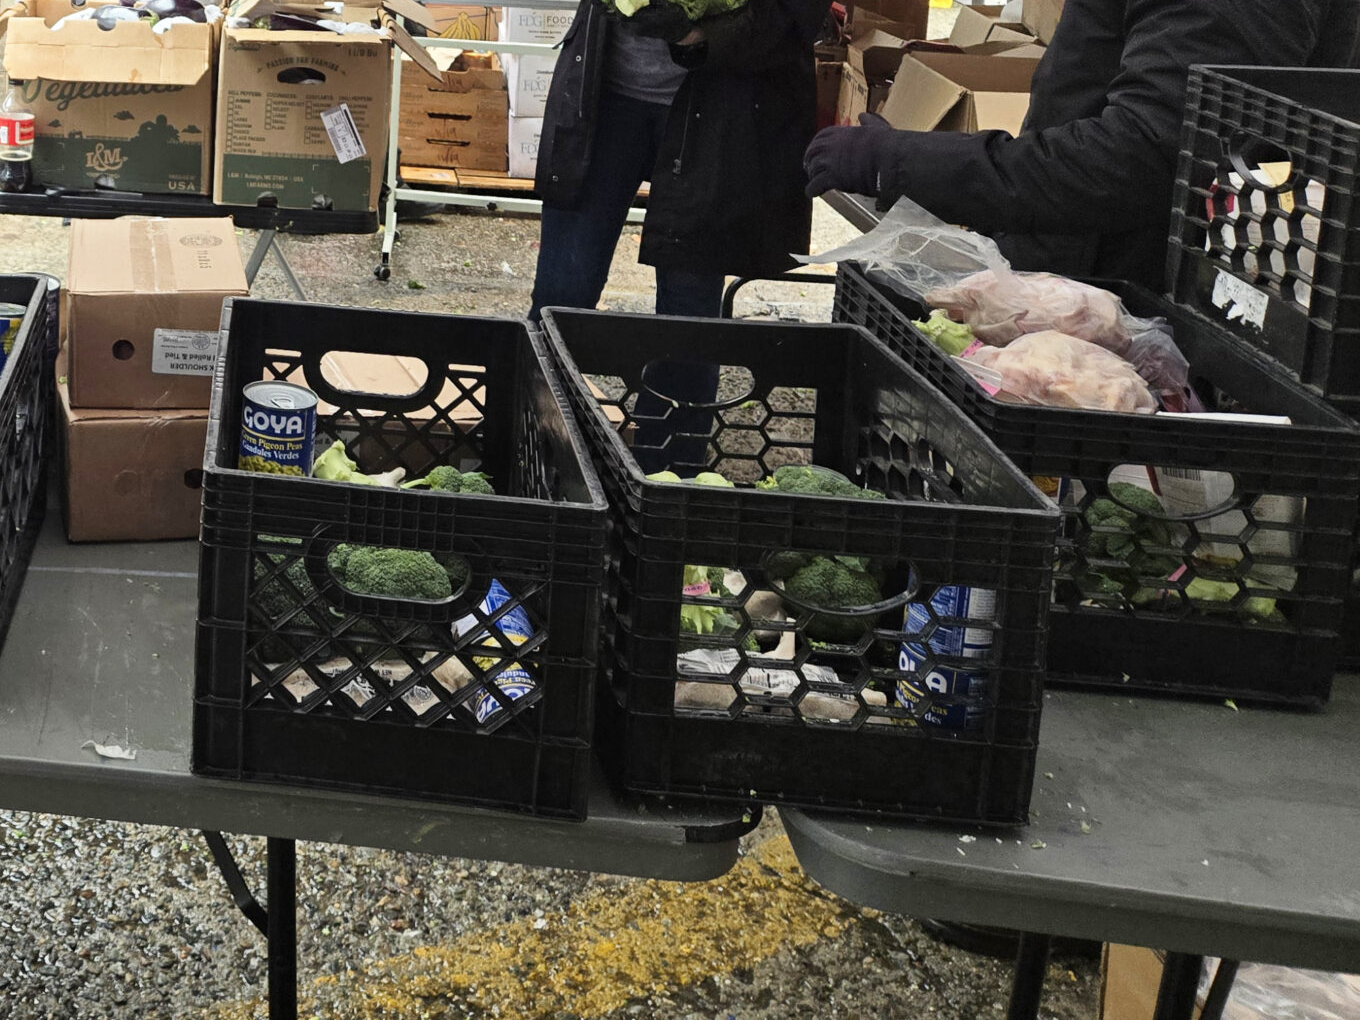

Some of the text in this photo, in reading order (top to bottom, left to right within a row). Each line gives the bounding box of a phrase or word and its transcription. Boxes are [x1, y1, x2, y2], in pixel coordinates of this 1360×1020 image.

[85, 143, 124, 171] L&M
[168, 180, 196, 192] USA
[165, 351, 211, 362] Rolled & Tied
[170, 362, 208, 372] SHOULDER
[243, 405, 303, 435] GOYA
[242, 440, 300, 460] Gandules Verdes
[258, 438, 285, 451] Pigeon
[286, 441, 303, 451] Peas
